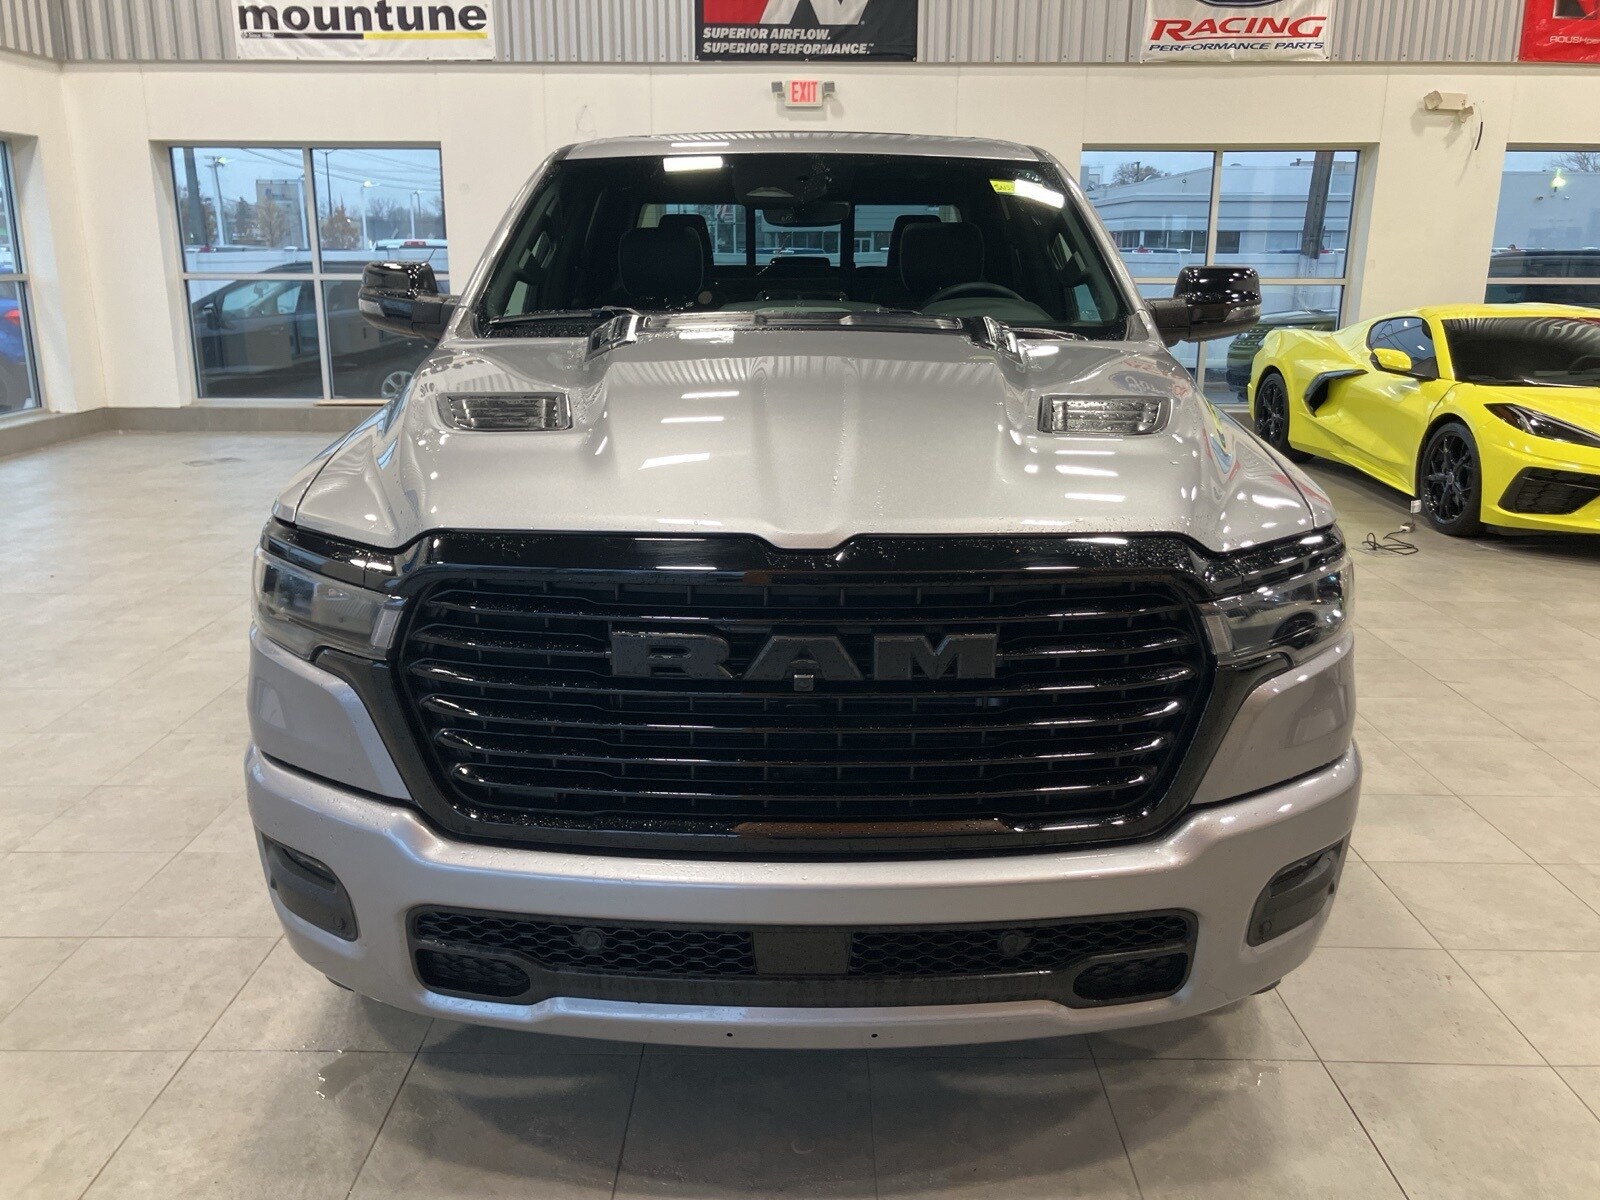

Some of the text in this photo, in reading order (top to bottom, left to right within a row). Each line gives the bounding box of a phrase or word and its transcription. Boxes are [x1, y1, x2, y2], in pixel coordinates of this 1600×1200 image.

[238, 0, 487, 31] mountune
[703, 27, 831, 40] SUPERIOR AIRFLOW.
[1150, 16, 1327, 41] RACING
[703, 42, 768, 54] SUPERIOR
[1149, 41, 1324, 51] PERFORMANCE PARTS
[791, 81, 818, 103] EXIT
[610, 631, 997, 681] RAM
